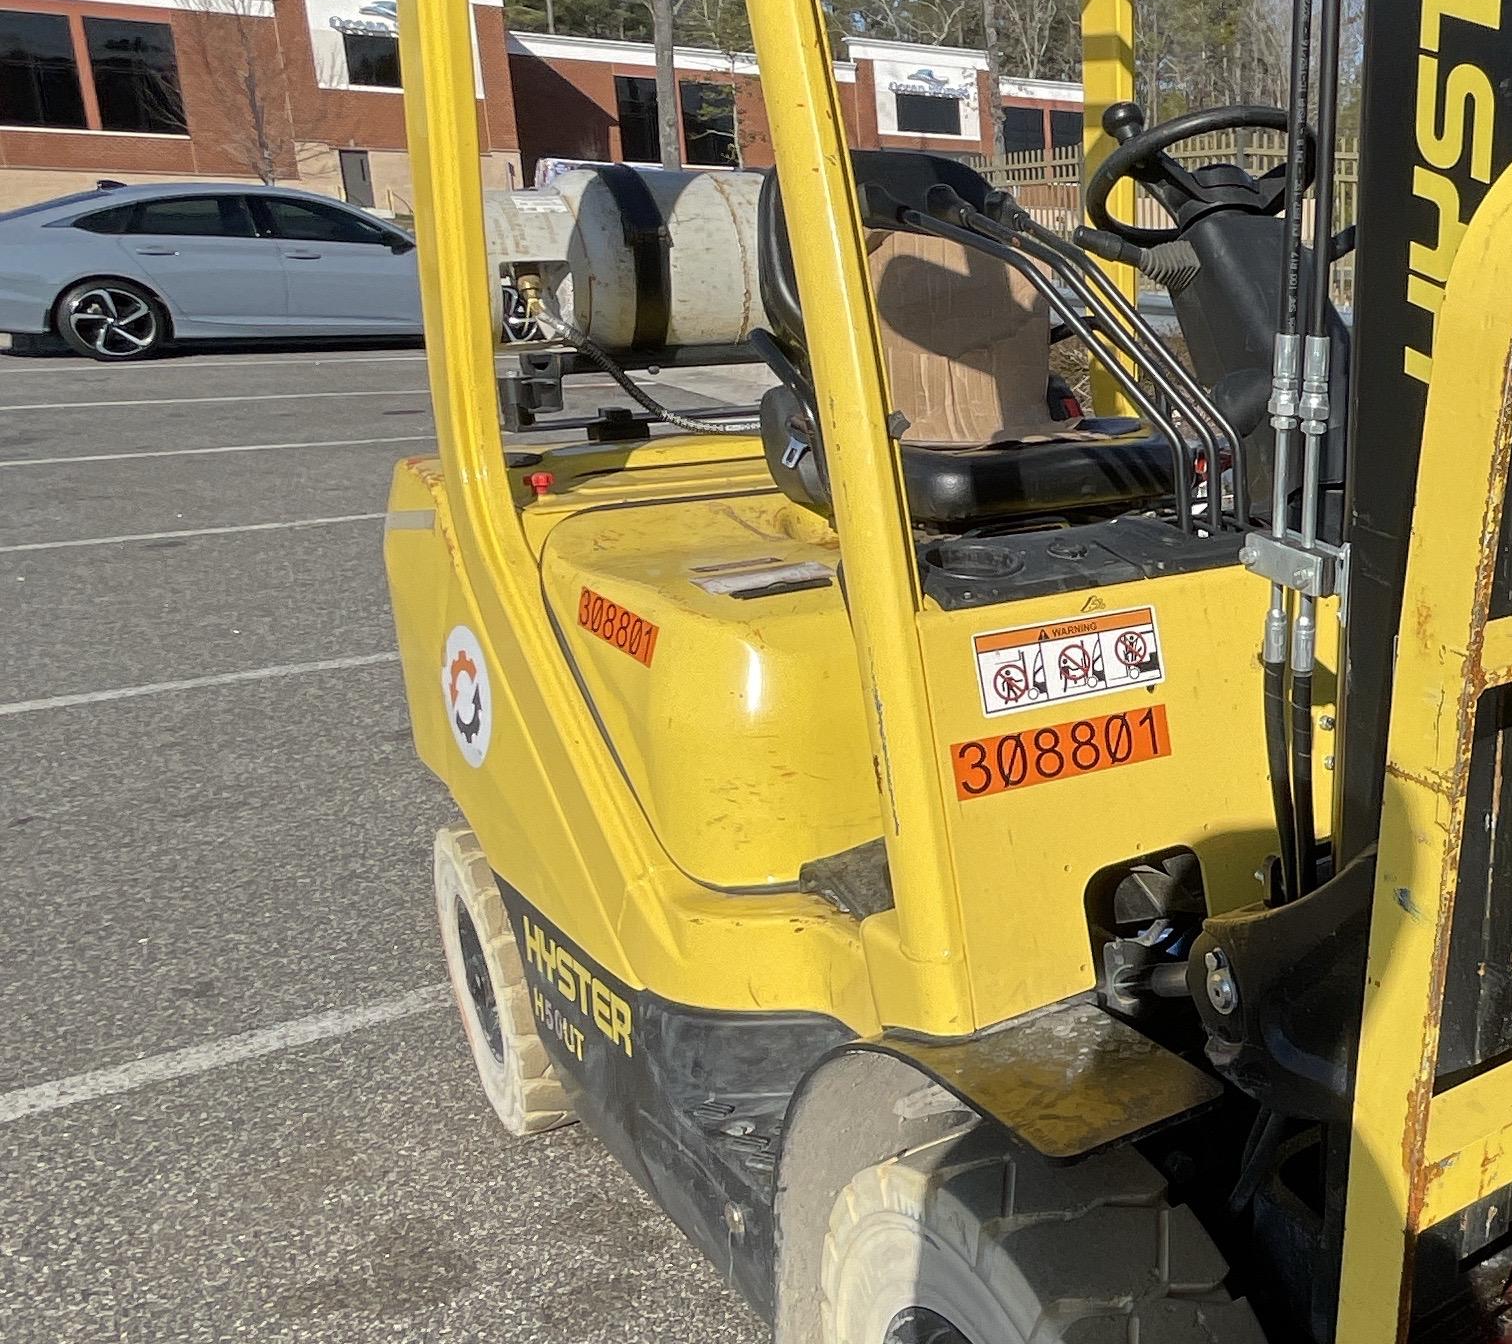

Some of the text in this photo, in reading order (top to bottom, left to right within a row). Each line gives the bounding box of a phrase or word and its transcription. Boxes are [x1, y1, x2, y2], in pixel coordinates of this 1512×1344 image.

[580, 589, 654, 664] 308801
[1051, 621, 1098, 639] WARNING
[958, 707, 1162, 795] 308801
[522, 915, 634, 1058] HYSTER
[533, 986, 585, 1061] H50UT
